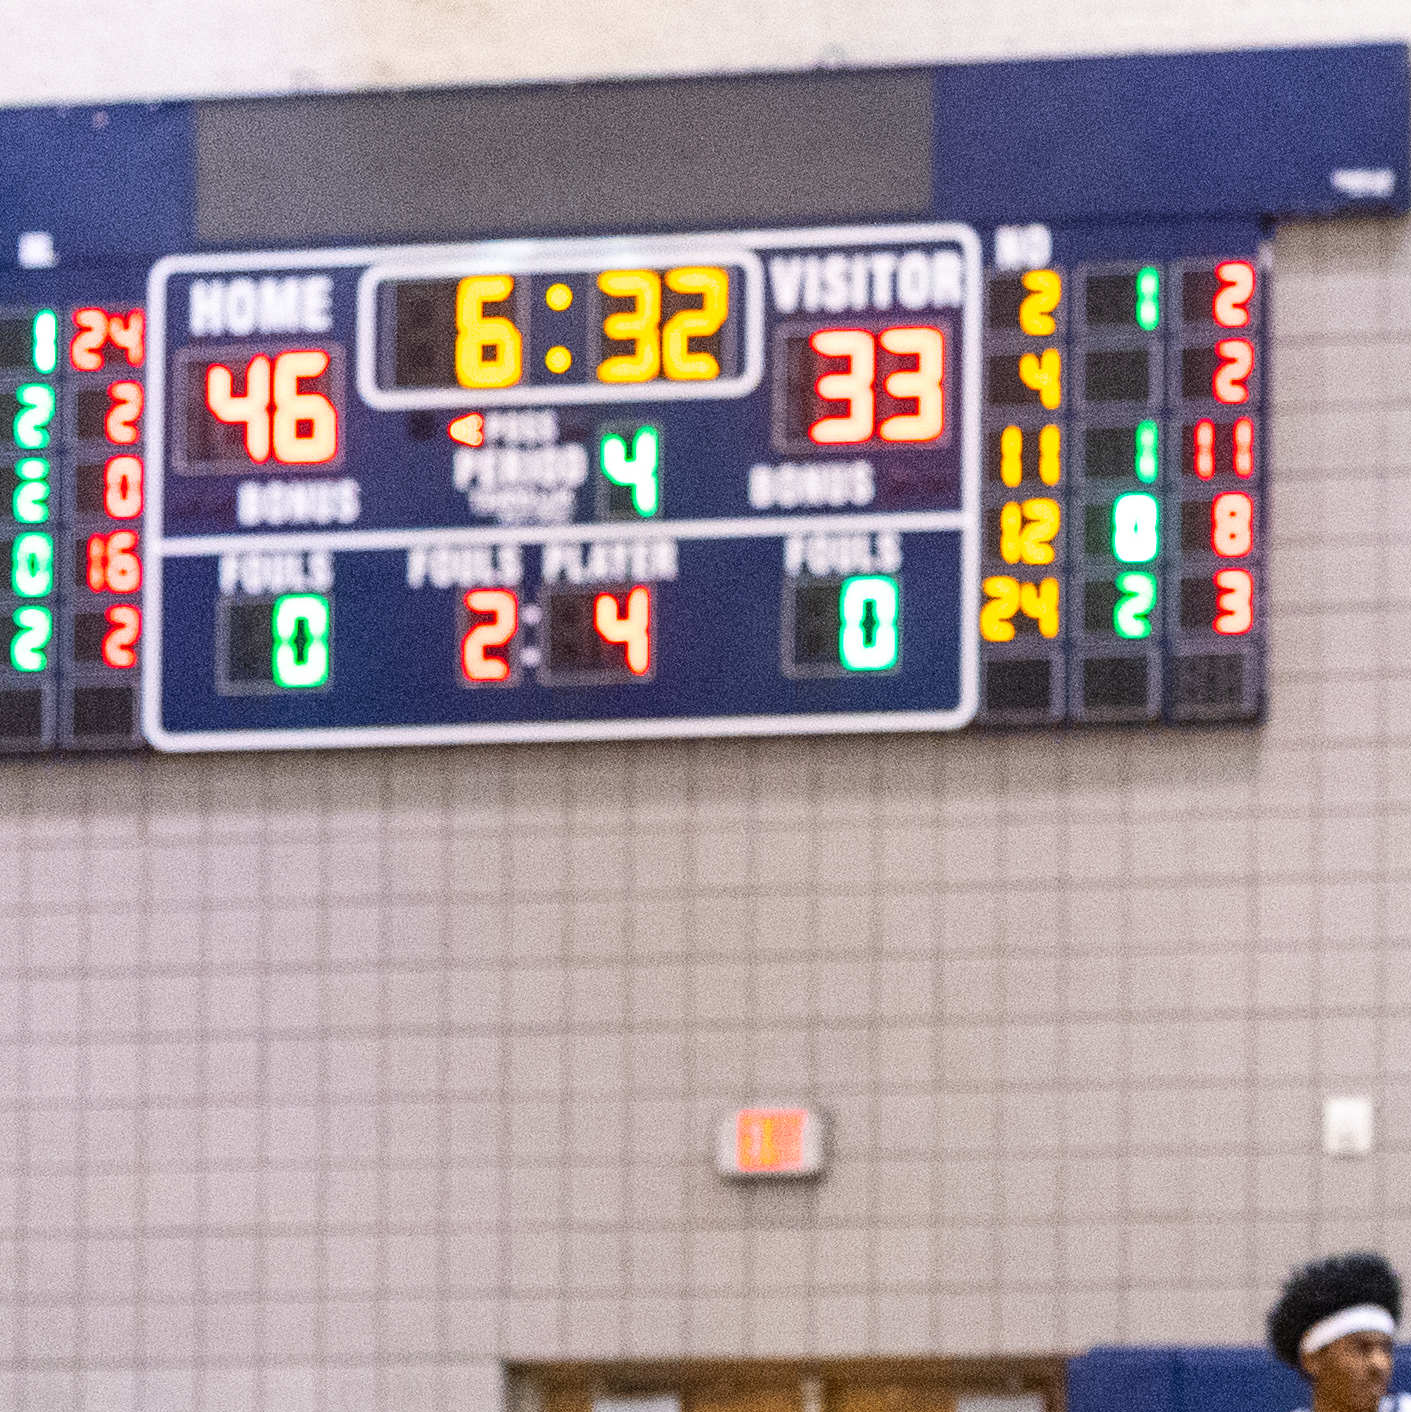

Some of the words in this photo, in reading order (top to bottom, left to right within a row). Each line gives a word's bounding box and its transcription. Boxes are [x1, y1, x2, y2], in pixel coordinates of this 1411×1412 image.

[189, 276, 332, 335] HOME
[770, 252, 963, 313] VISITOR
[1019, 269, 1061, 336] 2
[1135, 267, 1160, 330] 1
[1213, 261, 1255, 327] 2
[32, 308, 57, 374] 1
[70, 307, 146, 371] 24
[455, 266, 729, 389] 6:32
[808, 326, 944, 444] 33
[1019, 348, 1061, 410] 4
[1213, 338, 1255, 404] 2
[13, 382, 56, 449] 2
[105, 381, 143, 445] 2
[206, 350, 338, 464] 46
[453, 443, 588, 492] PERIOD
[600, 425, 659, 517] 4
[1000, 424, 1061, 488] 11
[1135, 420, 1159, 483] 1
[1193, 417, 1254, 480] 11
[103, 455, 144, 520] 0
[237, 478, 361, 524] BONUS
[750, 461, 875, 508] BONUS
[785, 531, 901, 578] FOULS
[1000, 498, 1061, 565] 12
[1112, 492, 1160, 563] 0
[1210, 492, 1254, 557] 8
[11, 530, 54, 597] 0
[87, 530, 143, 594] 16
[219, 550, 333, 594] FOULS
[407, 540, 522, 589] FOULS
[542, 540, 679, 586] PLAYER
[839, 575, 899, 671] 0
[979, 576, 1060, 642] 24
[1113, 570, 1157, 639] 2
[1212, 568, 1254, 635] 3
[11, 604, 53, 672] 2
[101, 604, 140, 669] 2
[273, 593, 330, 688] 0
